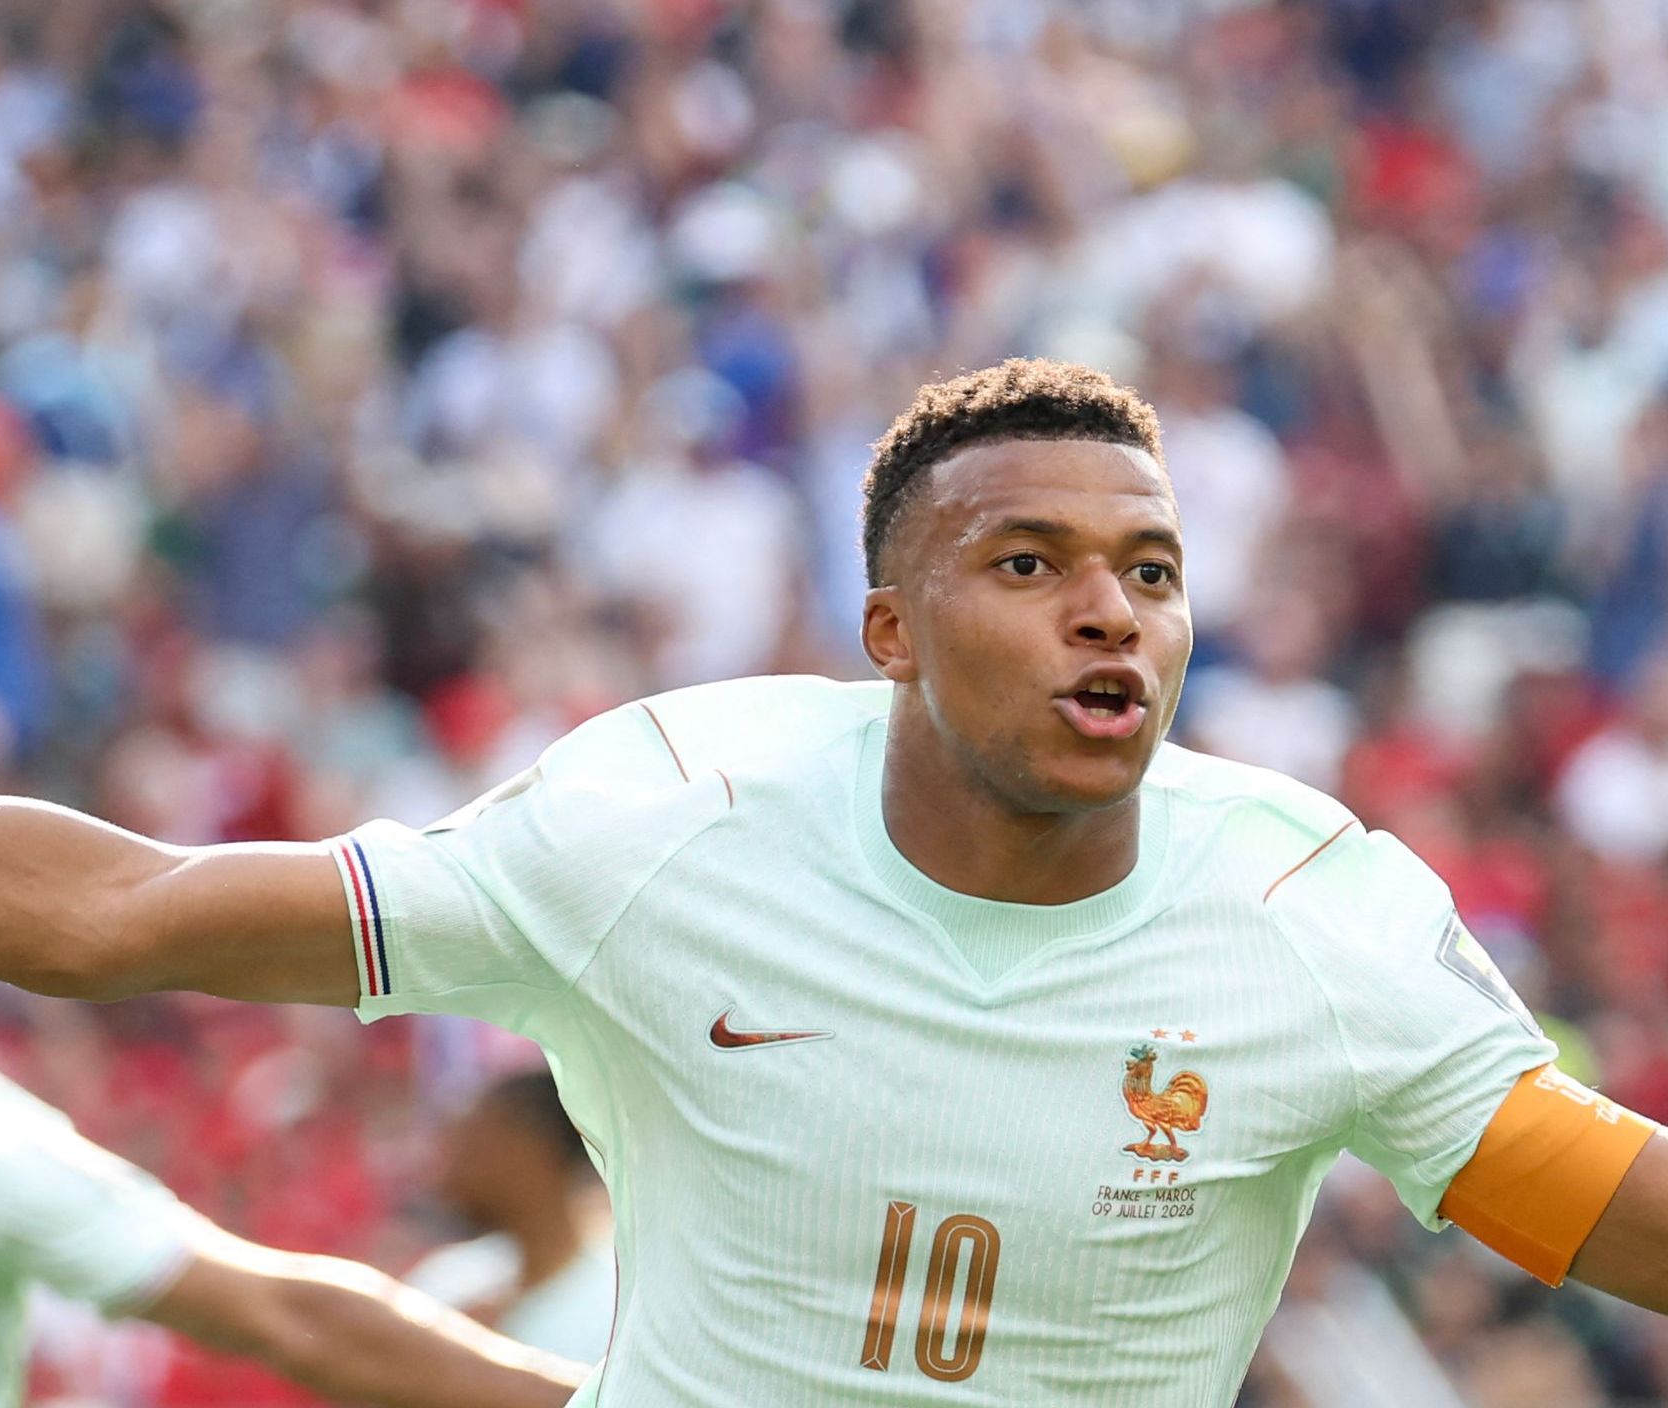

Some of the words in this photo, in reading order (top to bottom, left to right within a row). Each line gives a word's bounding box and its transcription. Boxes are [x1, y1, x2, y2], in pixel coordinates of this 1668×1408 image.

[1097, 1185, 1142, 1201] FRANCE
[1155, 1188, 1197, 1202] MAROC
[1092, 1201, 1112, 1217] 09
[1116, 1204, 1156, 1218] JUILLET
[1161, 1203, 1194, 1218] 2026
[860, 1200, 1001, 1382] 10
